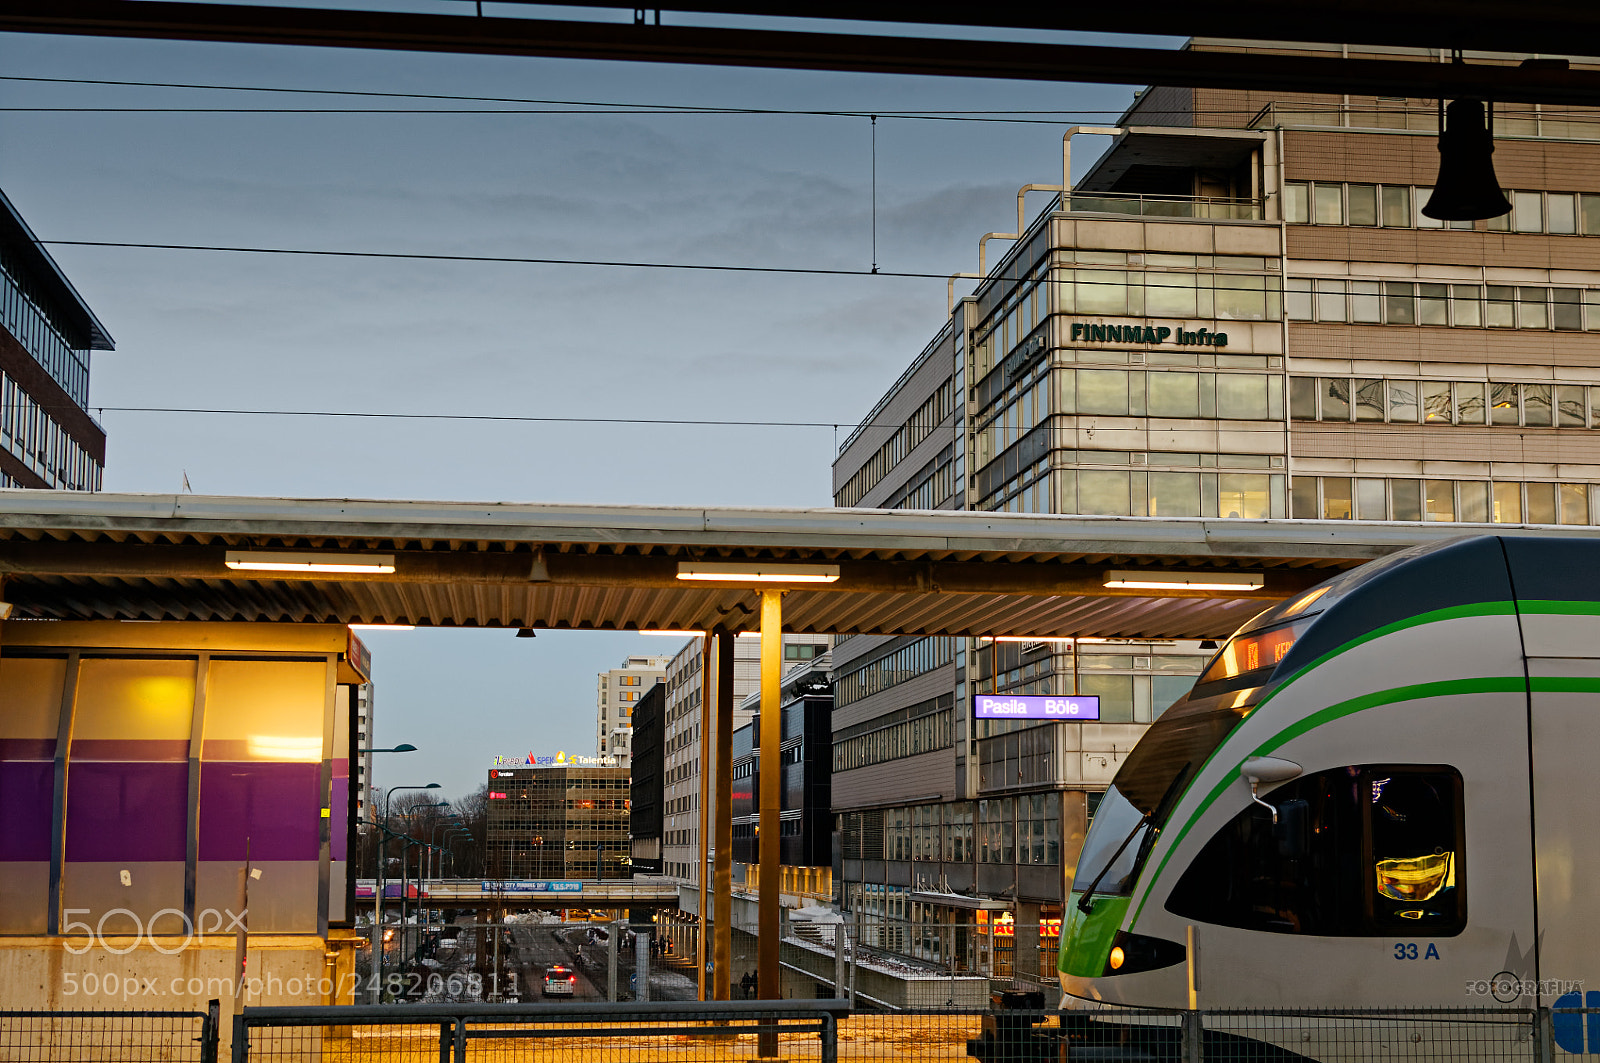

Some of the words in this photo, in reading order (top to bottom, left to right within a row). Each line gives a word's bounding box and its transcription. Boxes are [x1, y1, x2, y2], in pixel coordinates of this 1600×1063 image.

[1071, 323, 1170, 344] FINNMAP
[1177, 327, 1228, 346] Infra
[1274, 640, 1297, 662] KER
[983, 699, 1027, 714] Pasila
[1045, 700, 1079, 714] Böle
[578, 755, 616, 764] Talentia
[1393, 943, 1418, 960] 33
[1424, 943, 1440, 960] A
